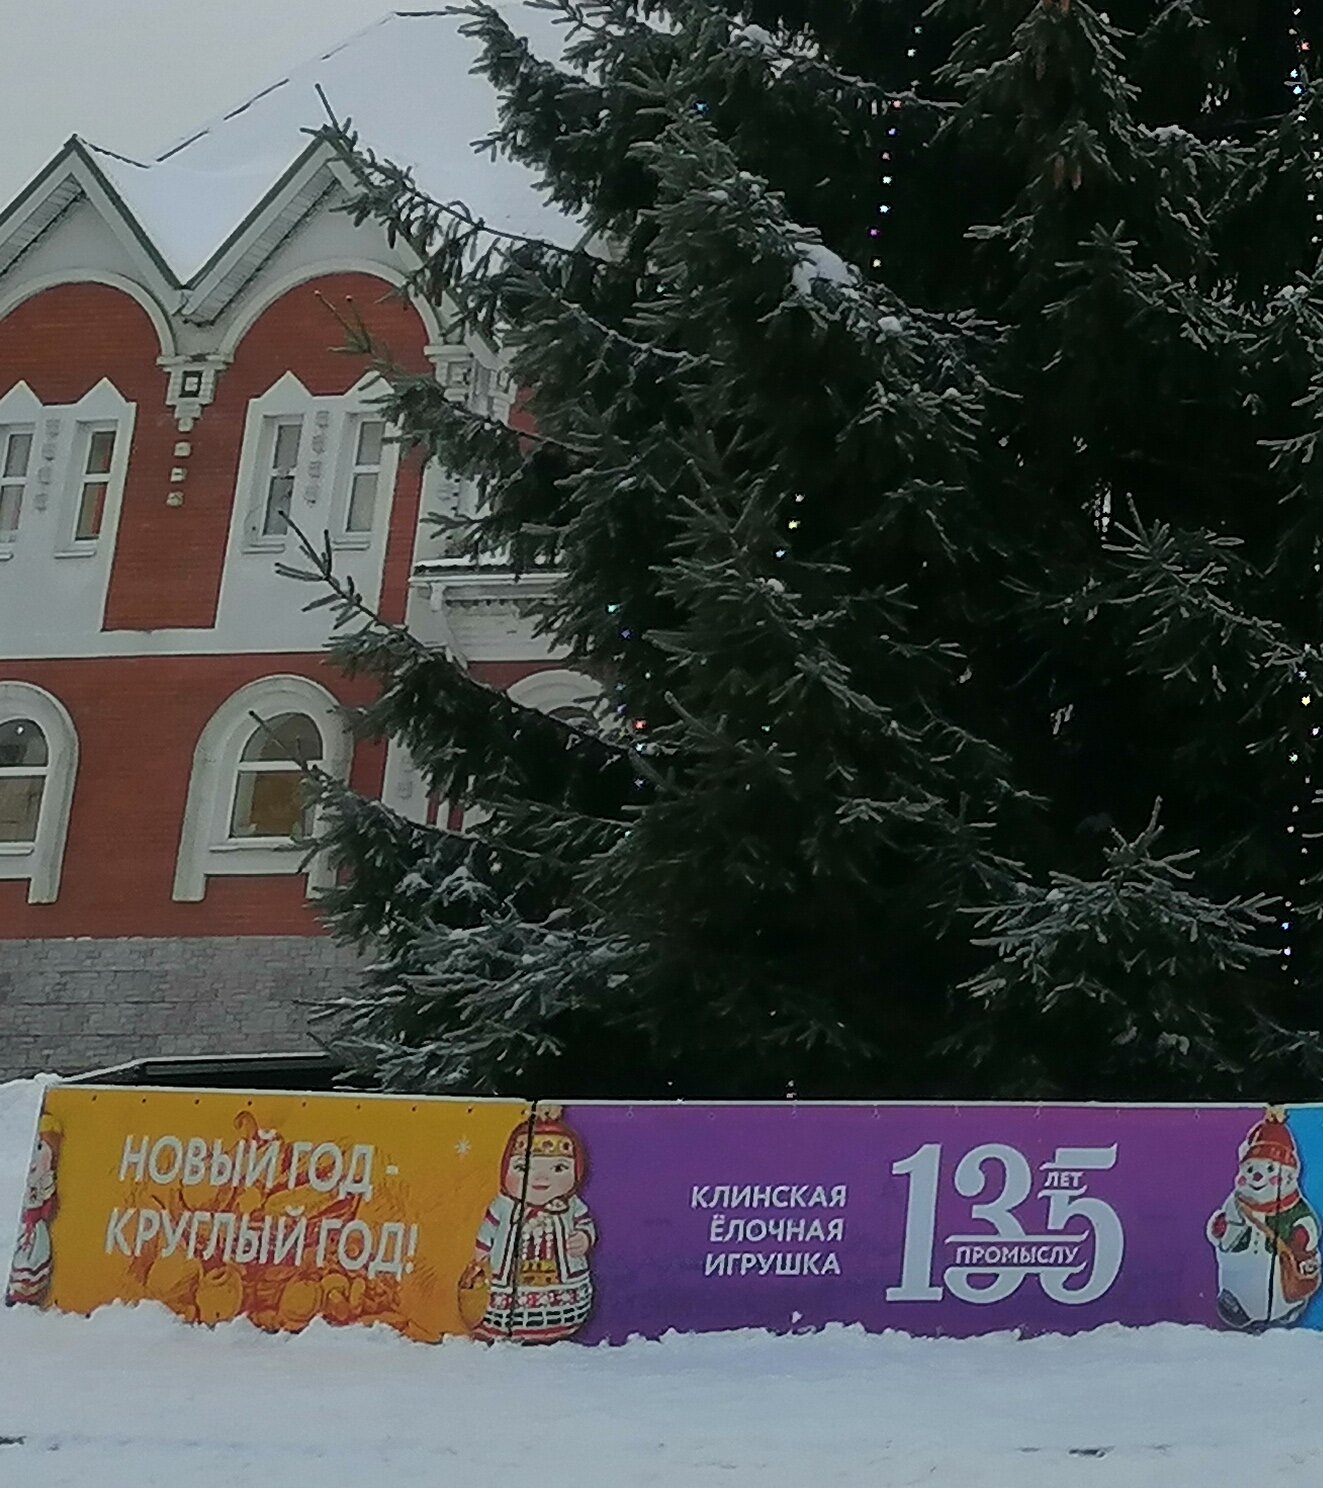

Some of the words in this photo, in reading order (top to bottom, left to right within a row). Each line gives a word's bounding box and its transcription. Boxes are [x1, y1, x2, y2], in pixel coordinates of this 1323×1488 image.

[119, 1128, 280, 1190] НОВЫЙ
[288, 1141, 375, 1201] ГОД
[1044, 1171, 1084, 1188] ЛЕТ
[691, 1184, 847, 1208] КЛИНСКАЯ
[710, 1214, 845, 1242] ЁЛОЧНАЯ
[886, 1143, 1124, 1304] 135
[105, 1205, 307, 1267] КРУГЛЫЙ
[316, 1218, 419, 1281] ГОД!
[955, 1246, 1079, 1264] ПРОМЫСЛУ
[704, 1252, 841, 1276] ИГРУШКА
